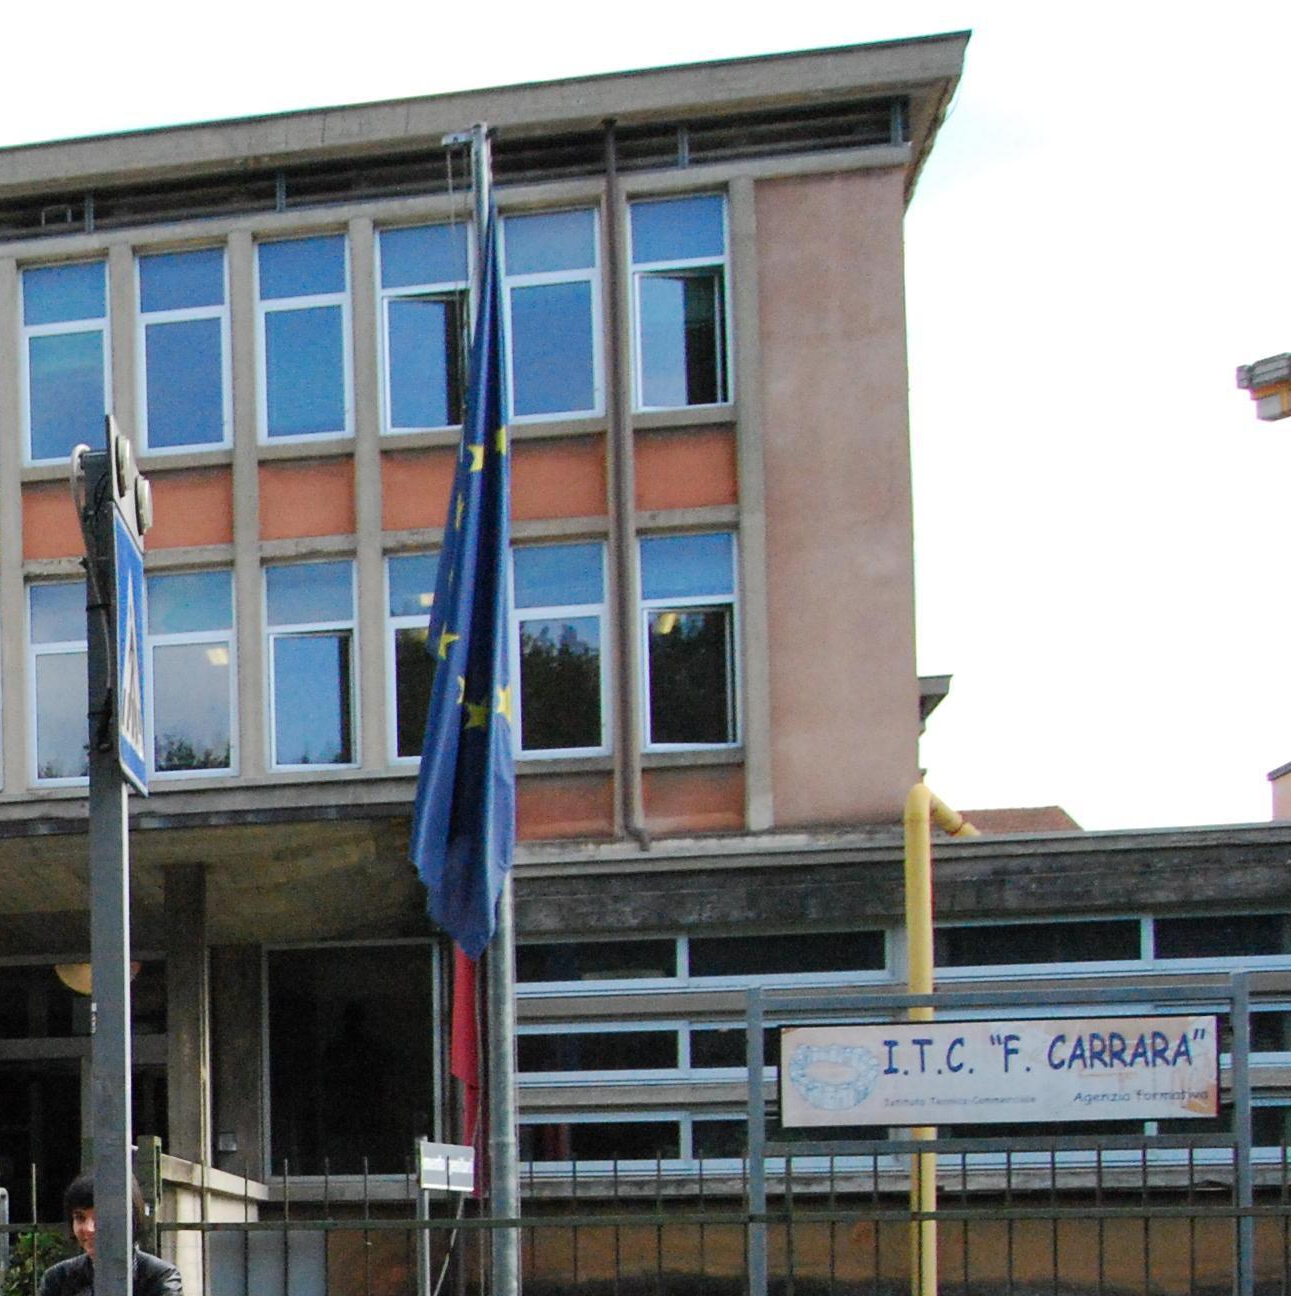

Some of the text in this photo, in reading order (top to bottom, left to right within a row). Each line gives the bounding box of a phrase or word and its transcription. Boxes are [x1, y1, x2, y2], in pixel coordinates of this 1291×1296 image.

[883, 1028, 1206, 1075] I.T.C. "F. CARRARA"
[1073, 1091, 1131, 1105] Agenzia
